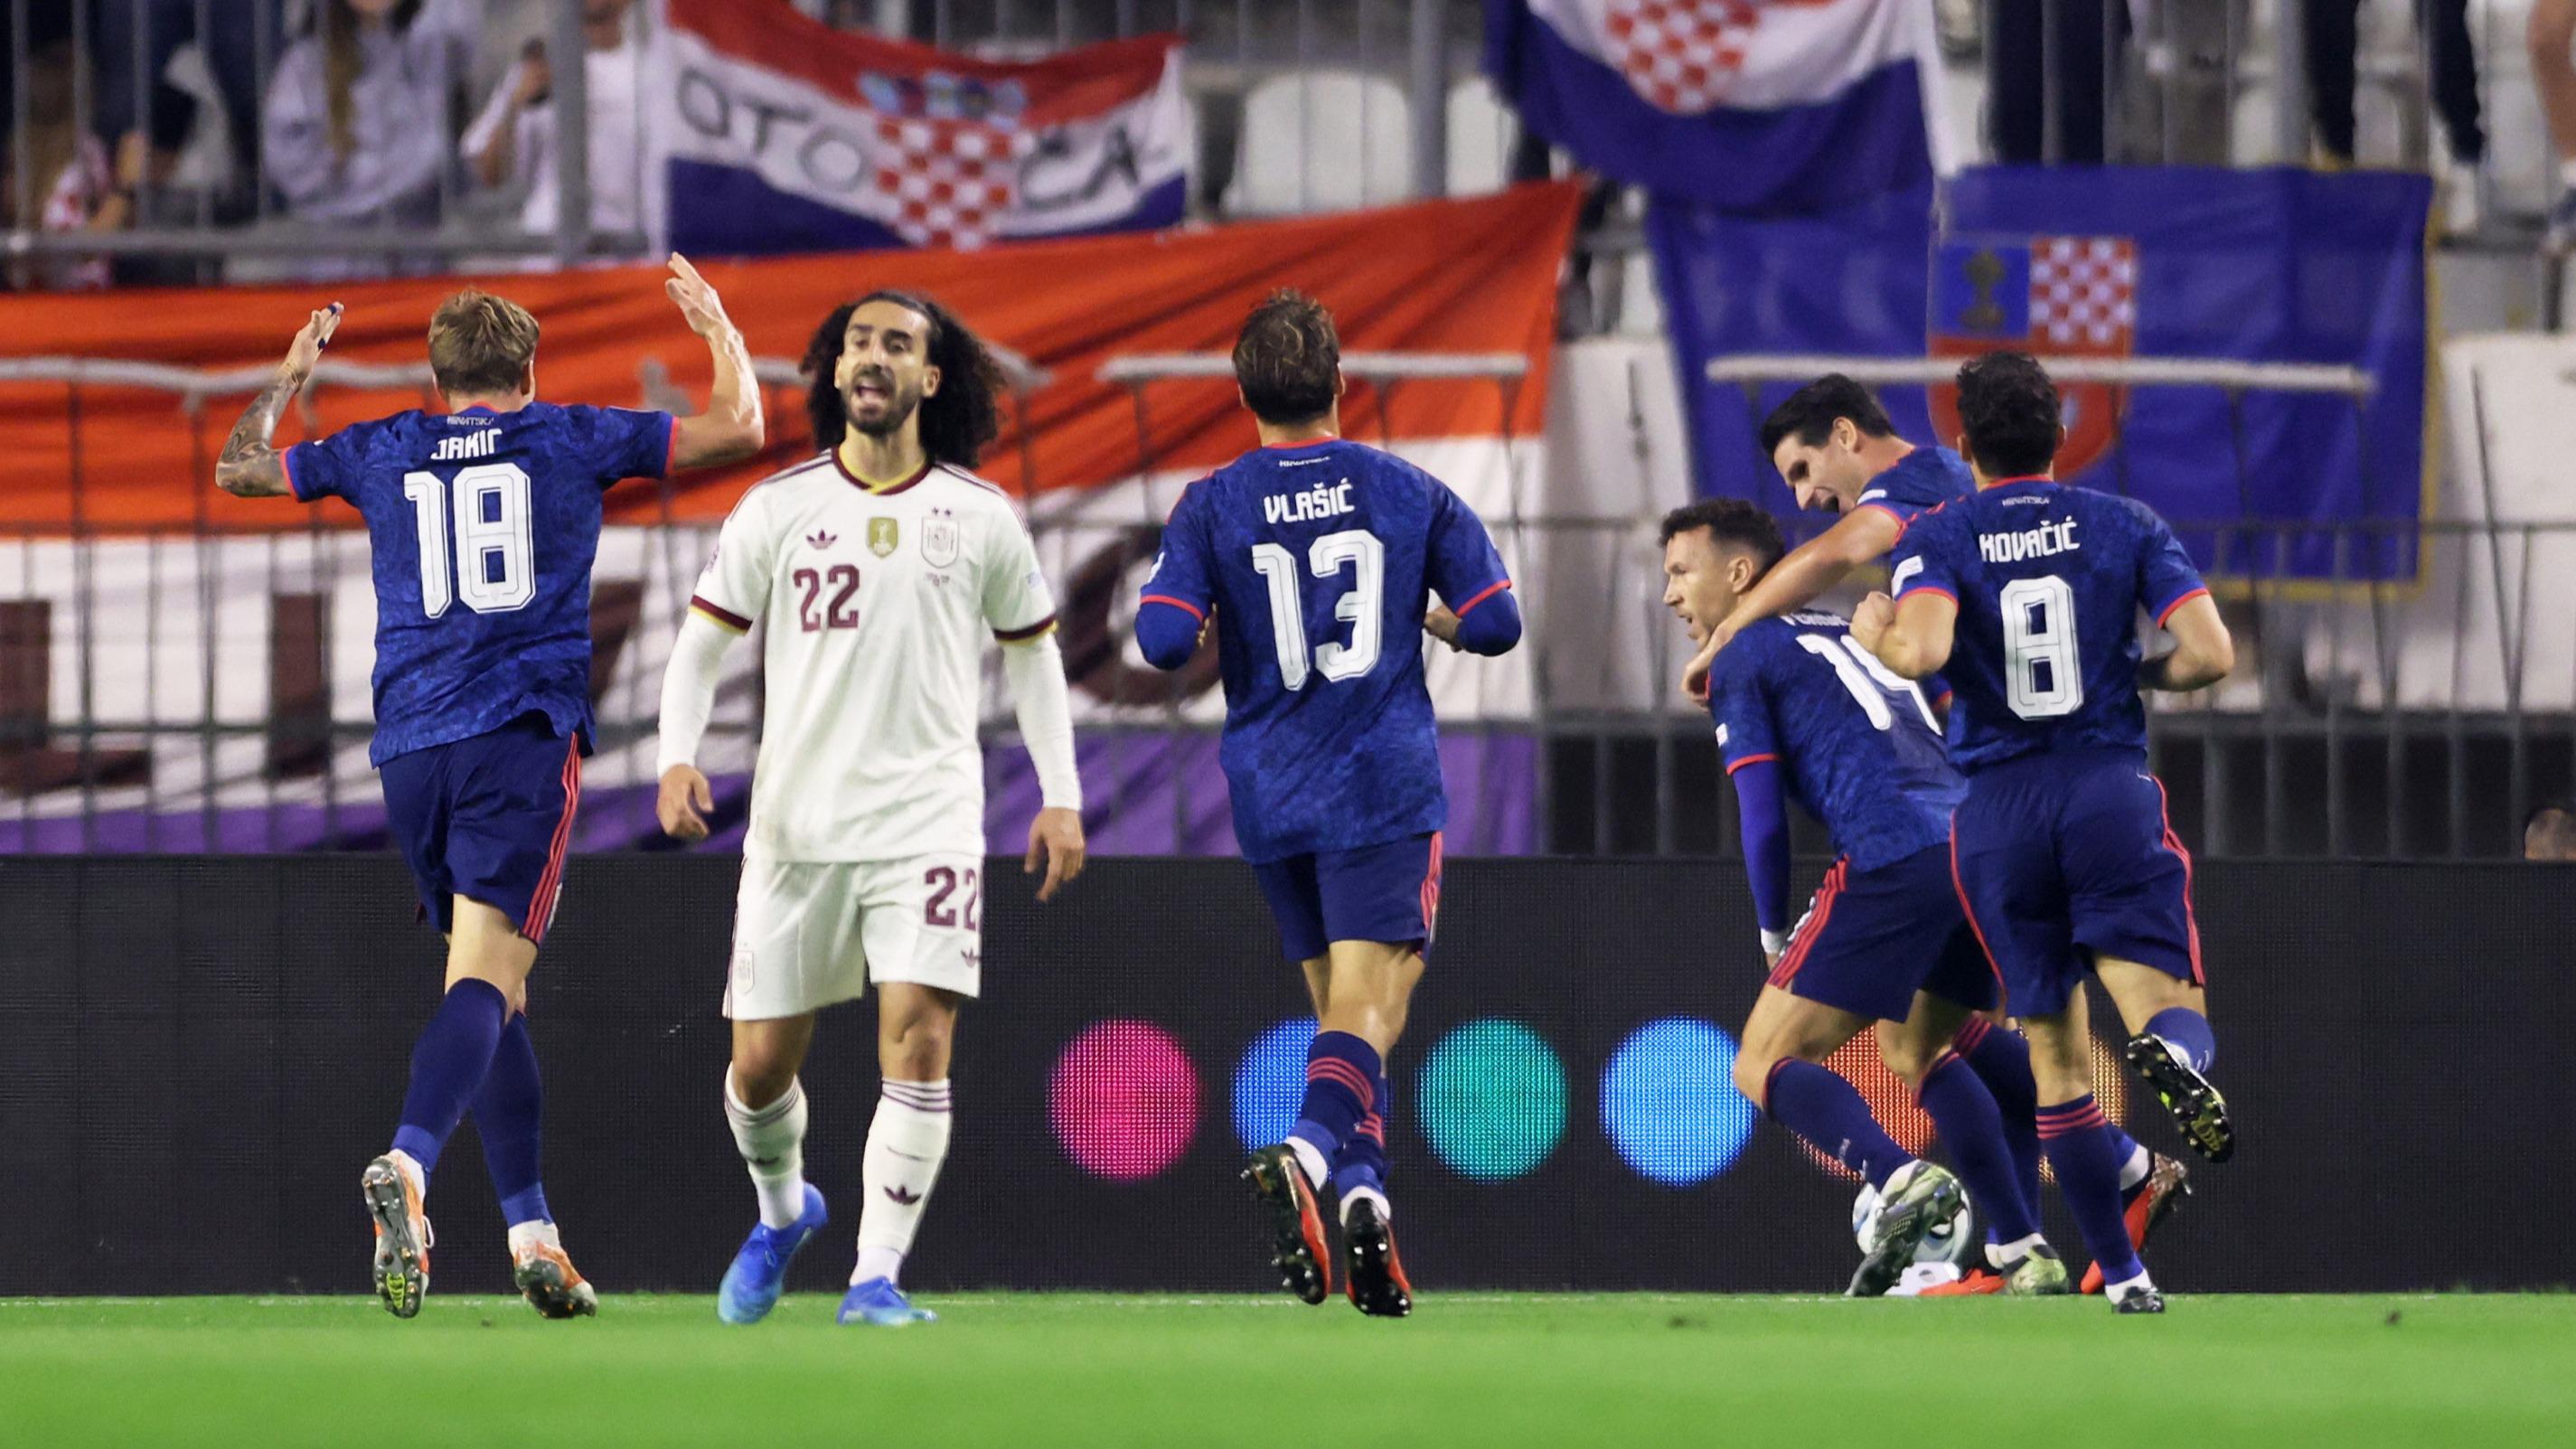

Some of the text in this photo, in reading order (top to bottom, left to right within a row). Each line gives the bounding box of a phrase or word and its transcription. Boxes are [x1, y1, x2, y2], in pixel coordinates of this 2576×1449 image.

[1264, 477, 1355, 523] VLAŠIĆ
[404, 462, 536, 618] 18
[1979, 515, 2080, 562] KOVAČIĆ
[793, 564, 860, 632] 22
[1252, 529, 1383, 692] 13
[2000, 575, 2083, 720] 8
[925, 867, 977, 932] 22
